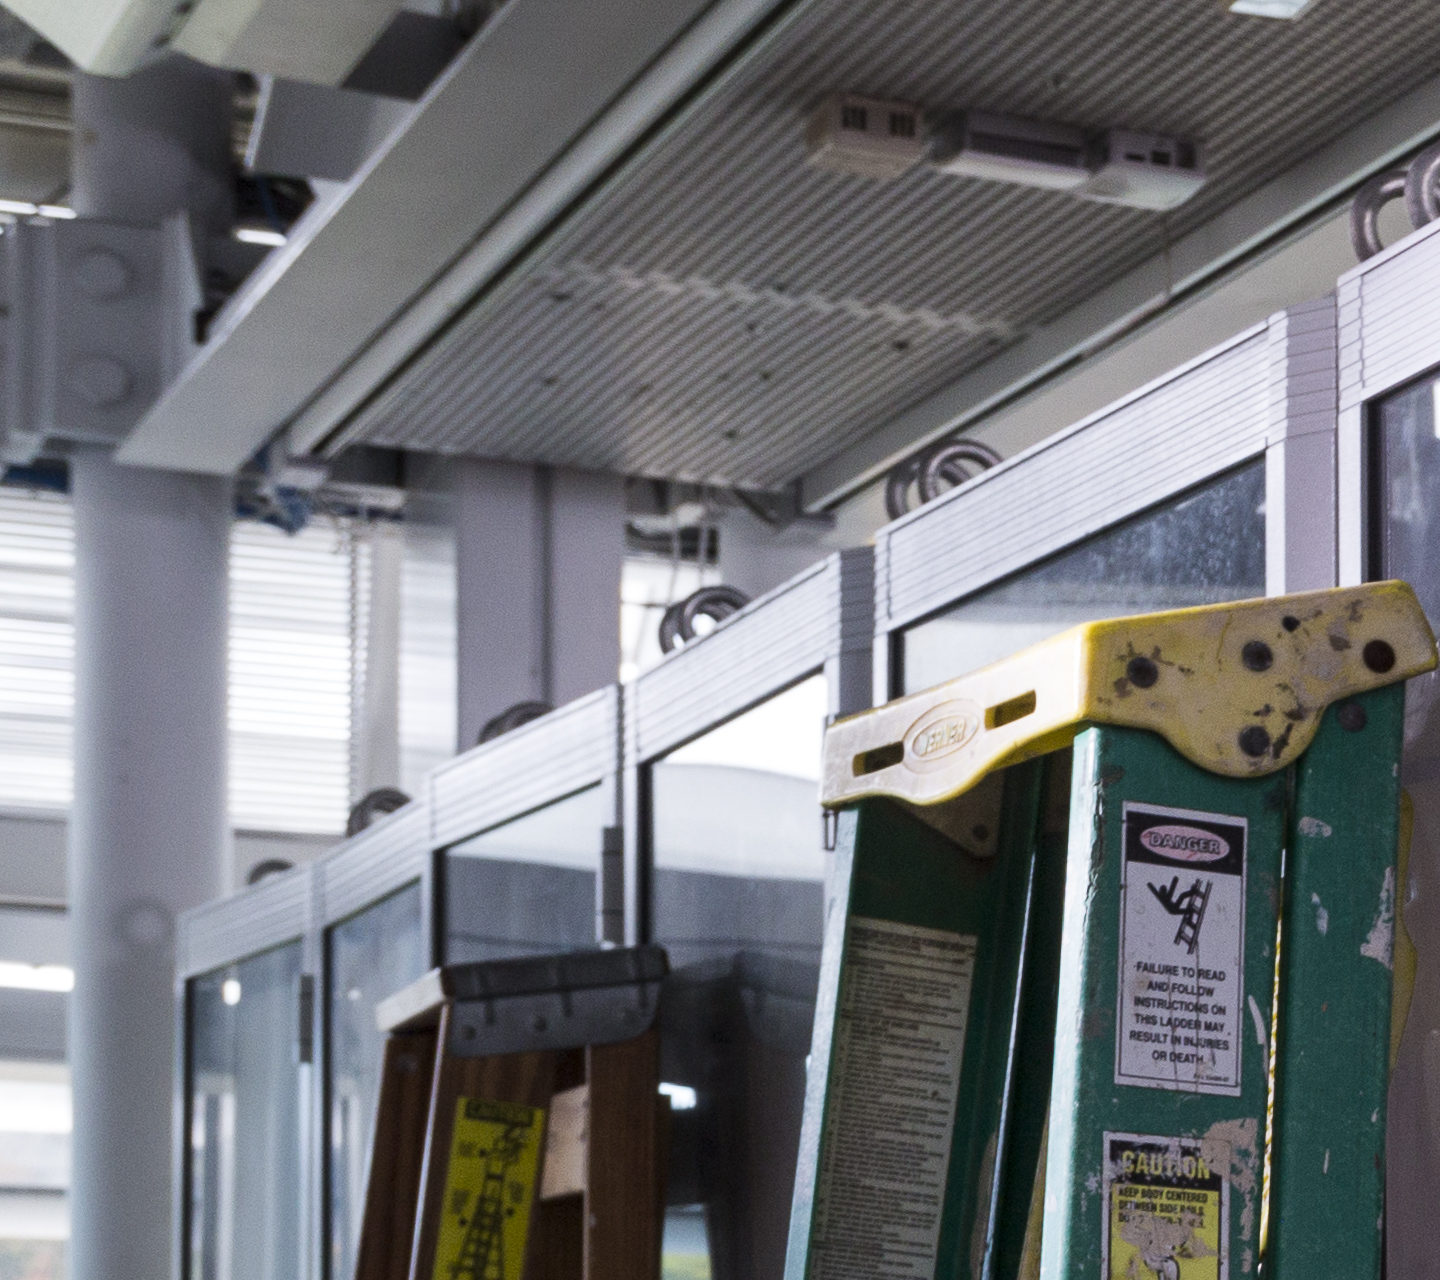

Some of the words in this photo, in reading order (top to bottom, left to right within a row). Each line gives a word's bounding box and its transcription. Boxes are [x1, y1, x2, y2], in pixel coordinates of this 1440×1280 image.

[1150, 831, 1220, 854] DANGER
[1136, 961, 1179, 976] FAILURE
[1182, 966, 1195, 978] TO
[1198, 969, 1225, 981] READ
[1147, 981, 1168, 992] AND
[1172, 983, 1214, 997] FOLLOW
[1134, 996, 1208, 1014] INSTRUCTIONS
[1211, 1004, 1226, 1015] ON
[1134, 1013, 1157, 1025] THIS
[1161, 1017, 1201, 1030] LADDER
[1204, 1021, 1224, 1032] MAY
[1129, 1030, 1168, 1044] RESULT
[1171, 1035, 1181, 1045] IN
[1184, 1037, 1229, 1050] INJURIES
[1152, 1050, 1167, 1061] OR
[1140, 1188, 1163, 1199] BODY
[1166, 1190, 1208, 1203] CENTERED
